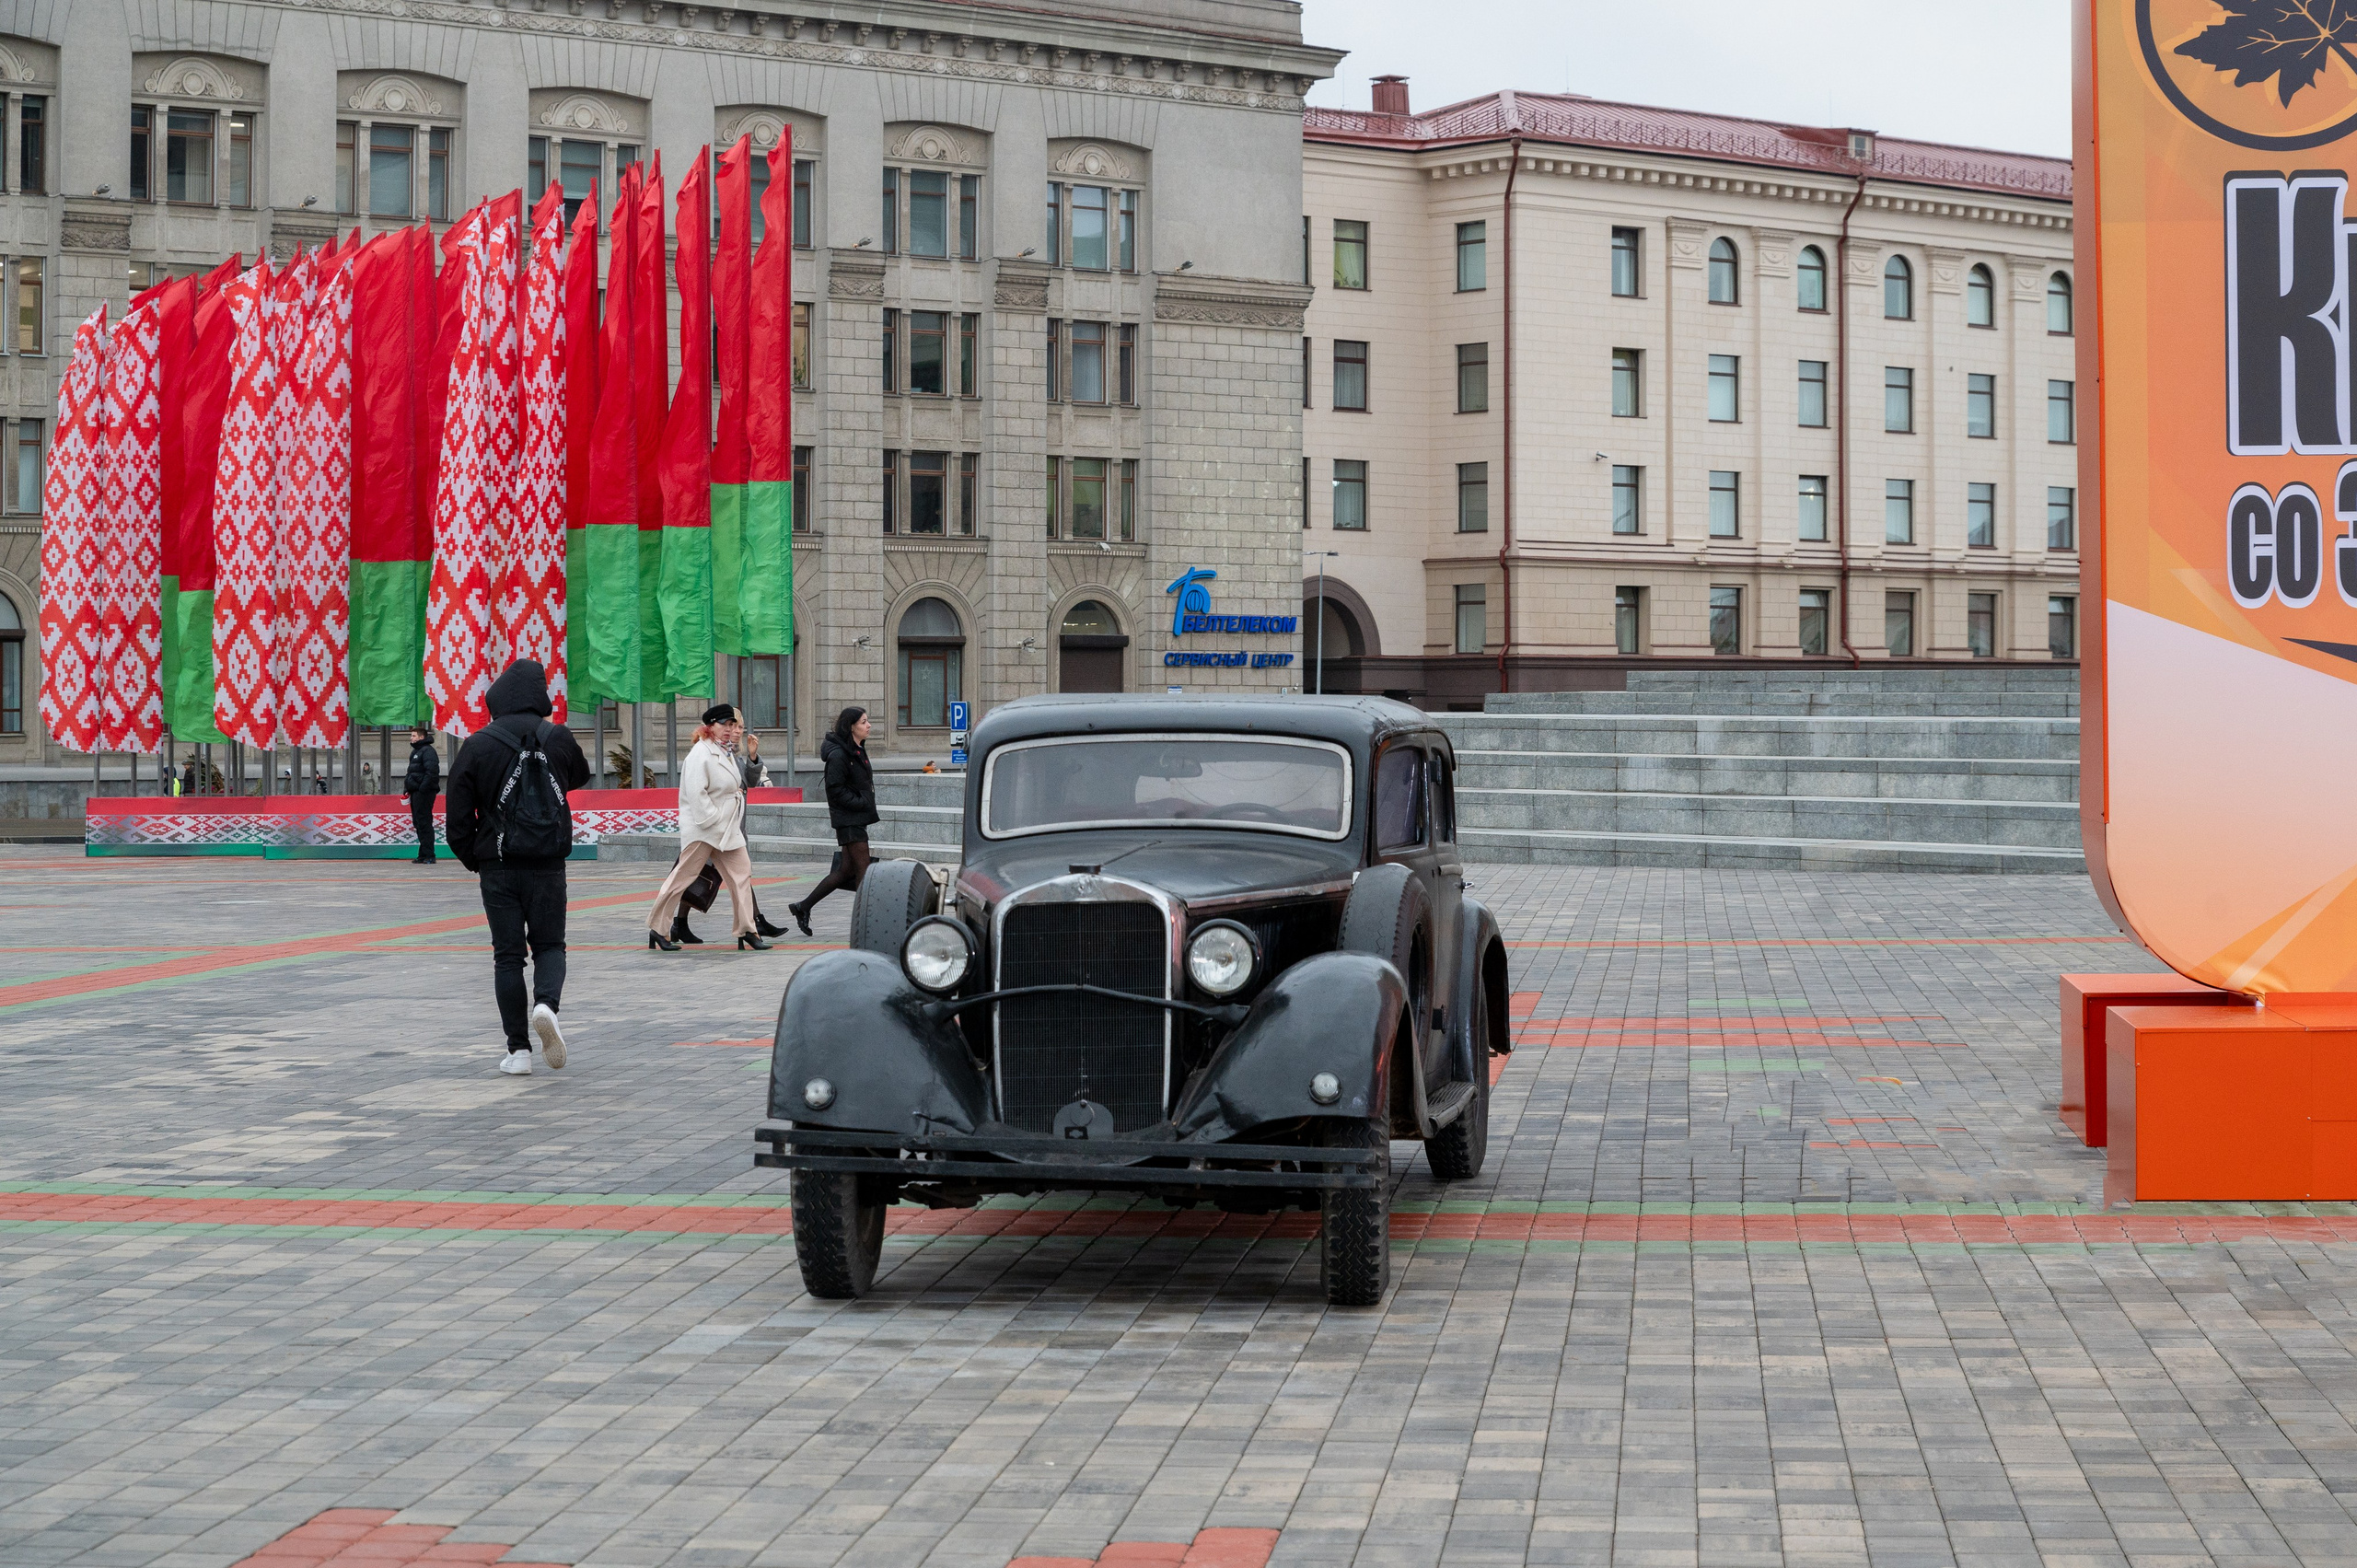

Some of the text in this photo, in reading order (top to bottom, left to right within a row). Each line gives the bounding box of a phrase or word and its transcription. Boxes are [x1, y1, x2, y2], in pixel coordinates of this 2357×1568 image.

[2223, 169, 2357, 456] К
[1184, 615, 1297, 633] БЕЛТЕЛЕКОМ
[1164, 650, 1294, 669] СЕРВИСНЫЙ ЦЕНТР
[500, 776, 517, 804] PROVE
